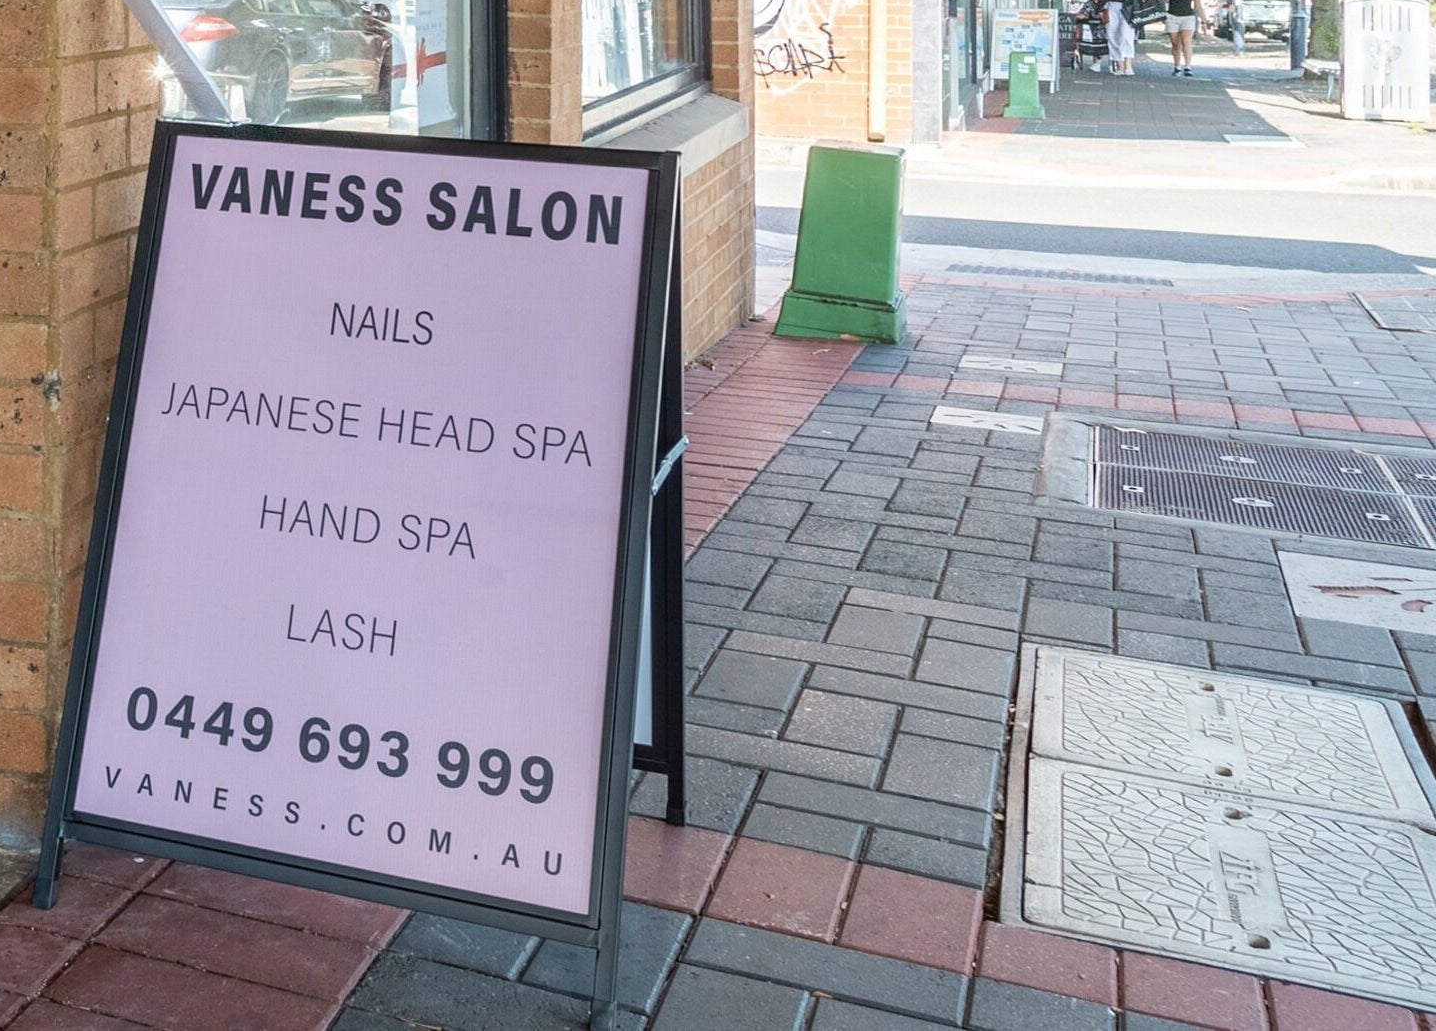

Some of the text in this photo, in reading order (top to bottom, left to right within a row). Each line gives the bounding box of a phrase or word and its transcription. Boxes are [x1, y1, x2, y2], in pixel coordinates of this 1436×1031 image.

[192, 163, 623, 245] VANESS SALON
[330, 302, 435, 345] NAILS
[161, 382, 593, 467] JAPANESE HEAD SPA
[260, 495, 476, 560] HAND SPA
[286, 604, 398, 657] LASH
[126, 686, 555, 805] 0449 693 999
[104, 766, 563, 876] VANESS.COM.AU
